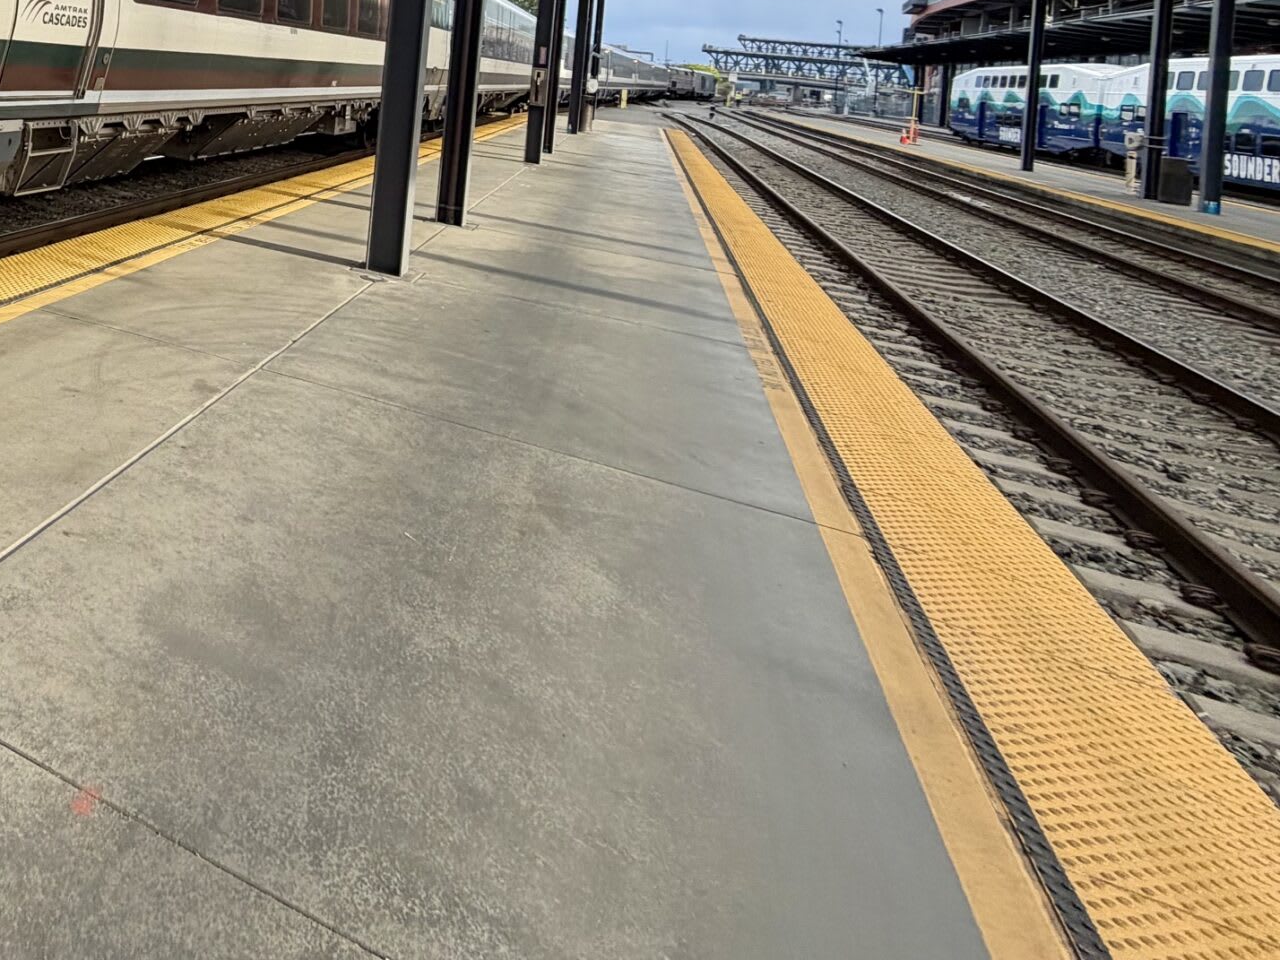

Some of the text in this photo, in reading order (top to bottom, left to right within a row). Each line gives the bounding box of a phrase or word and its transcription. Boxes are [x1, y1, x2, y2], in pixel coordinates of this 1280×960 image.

[54, 3, 89, 14] AMTRAK
[42, 11, 88, 29] CASCADES
[1223, 153, 1280, 184] SOUNDER
